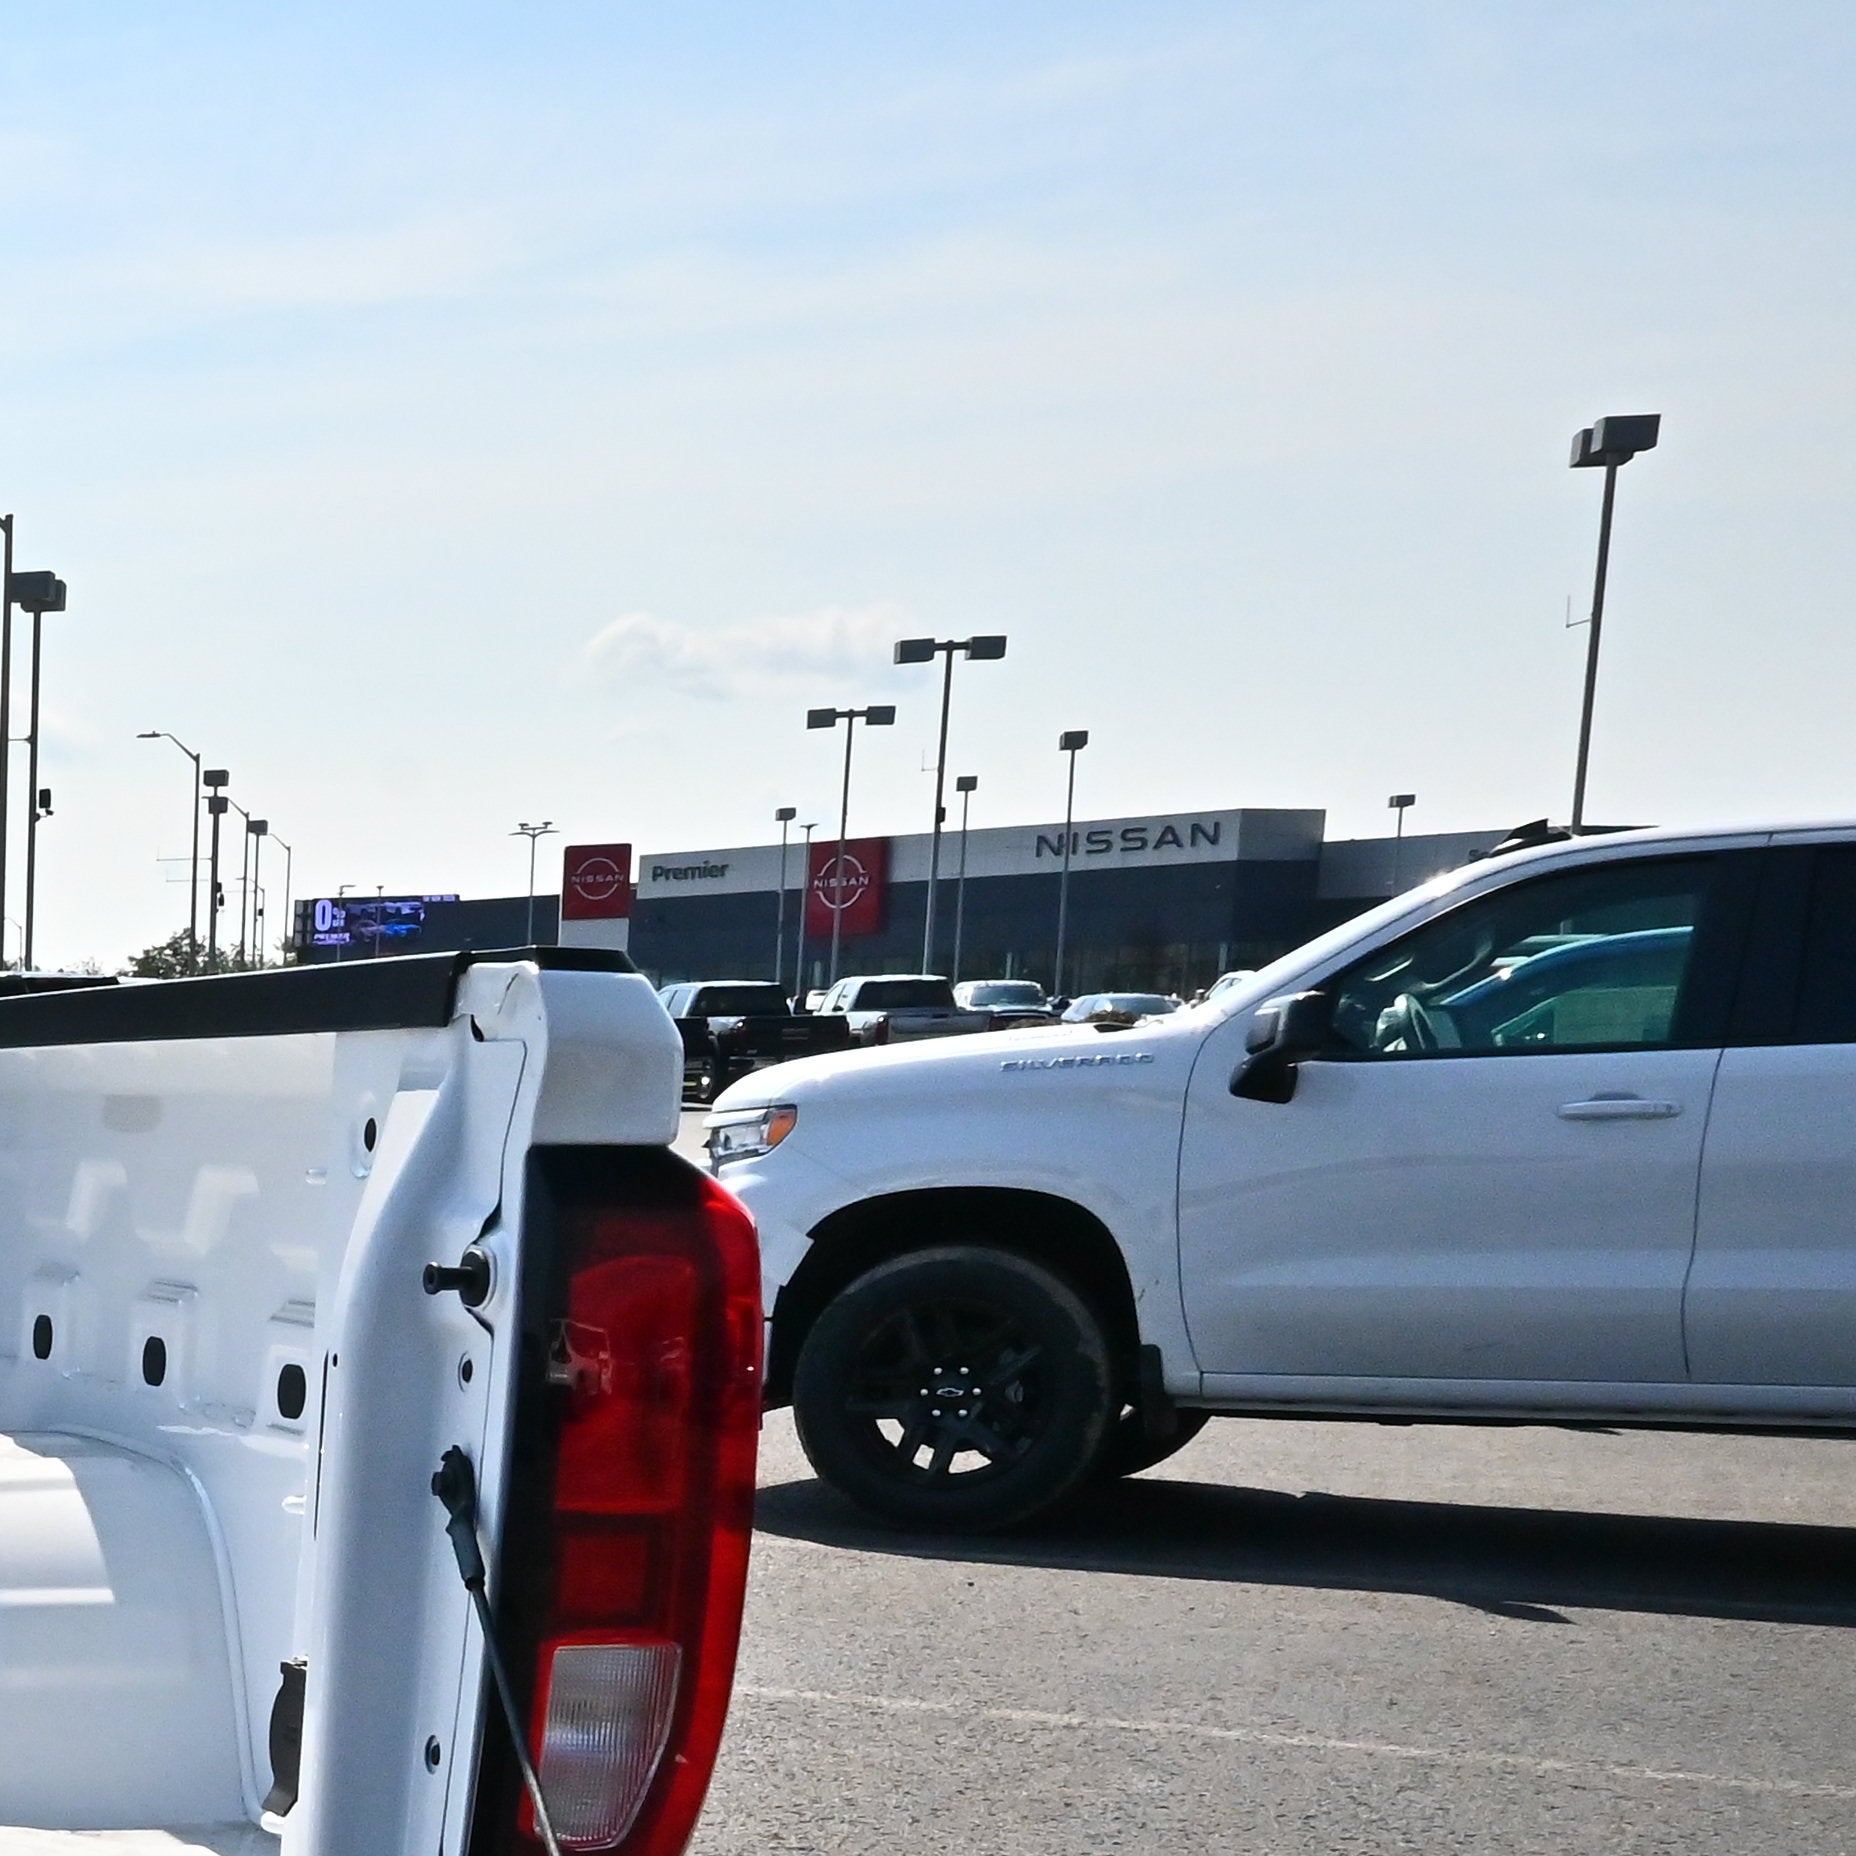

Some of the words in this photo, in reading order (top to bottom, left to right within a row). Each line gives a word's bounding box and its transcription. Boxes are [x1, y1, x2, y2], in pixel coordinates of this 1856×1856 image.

[1036, 821, 1220, 858] NISSAN
[571, 873, 625, 885] NISSAN
[652, 860, 730, 882] Premier
[999, 1053, 1155, 1072] SILVERADO
